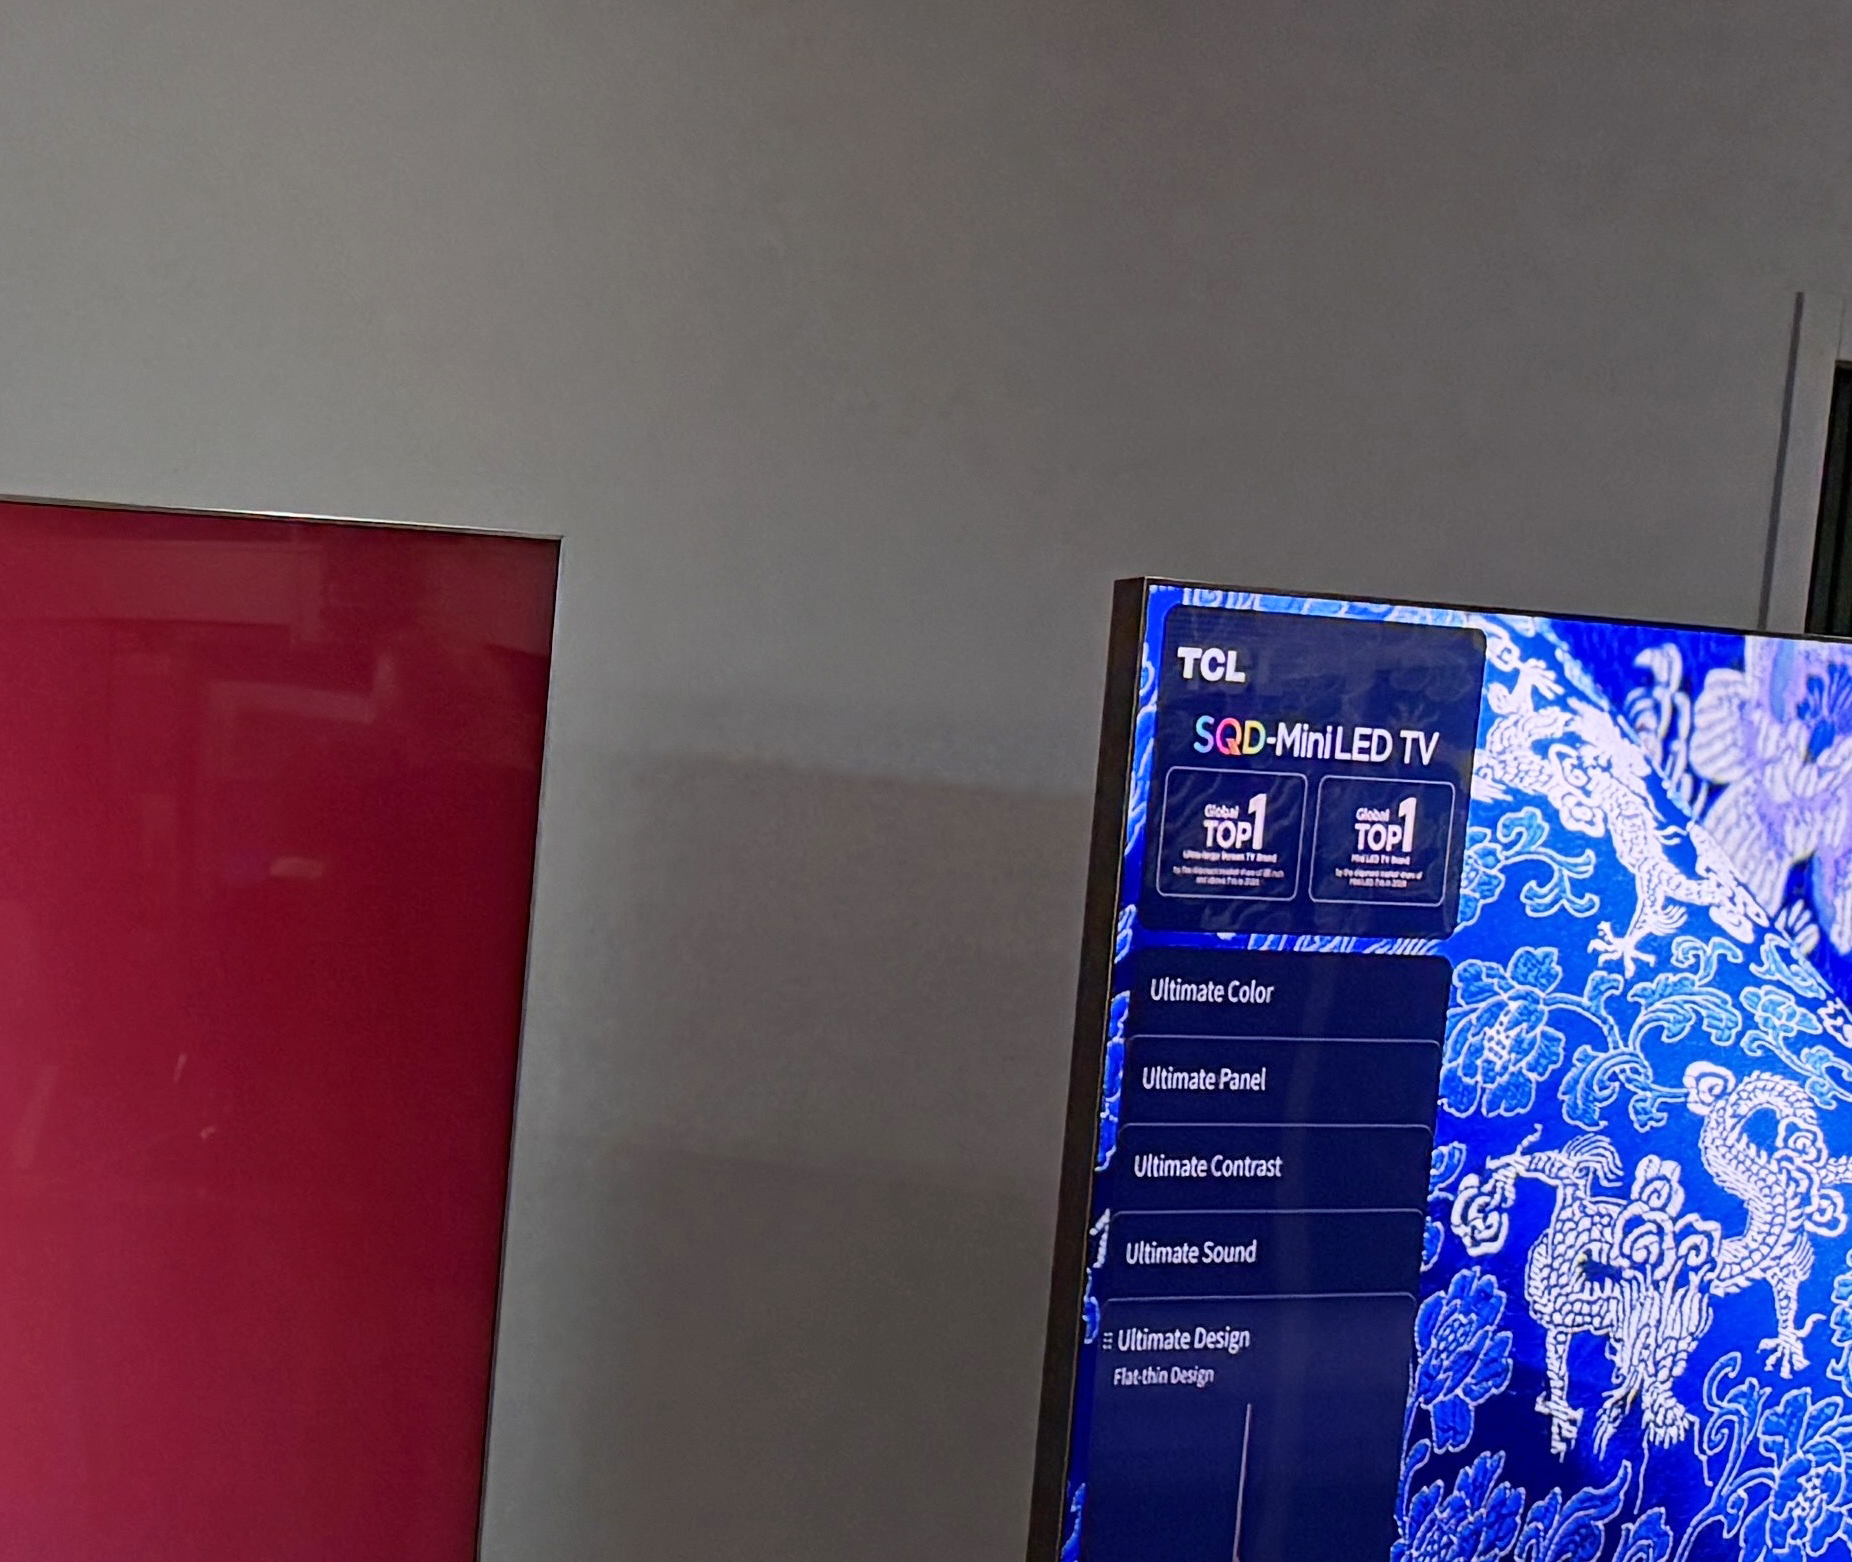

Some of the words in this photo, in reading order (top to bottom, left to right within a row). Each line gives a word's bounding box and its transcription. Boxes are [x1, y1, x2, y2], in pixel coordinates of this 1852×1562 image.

[1177, 646, 1246, 683] TCL
[1399, 729, 1441, 765] TV
[1150, 977, 1225, 1003] Ultimate
[1227, 979, 1274, 1003] Color
[1142, 1066, 1216, 1090] Ultimate
[1219, 1067, 1266, 1091] Panel
[1134, 1153, 1208, 1177] Ultimate
[1211, 1154, 1283, 1177] Contrast
[1126, 1240, 1199, 1264] Ultimate
[1201, 1239, 1257, 1264] Sound
[1117, 1328, 1191, 1351] Ultimate
[1194, 1325, 1250, 1354] Design
[1170, 1365, 1214, 1388] Design
